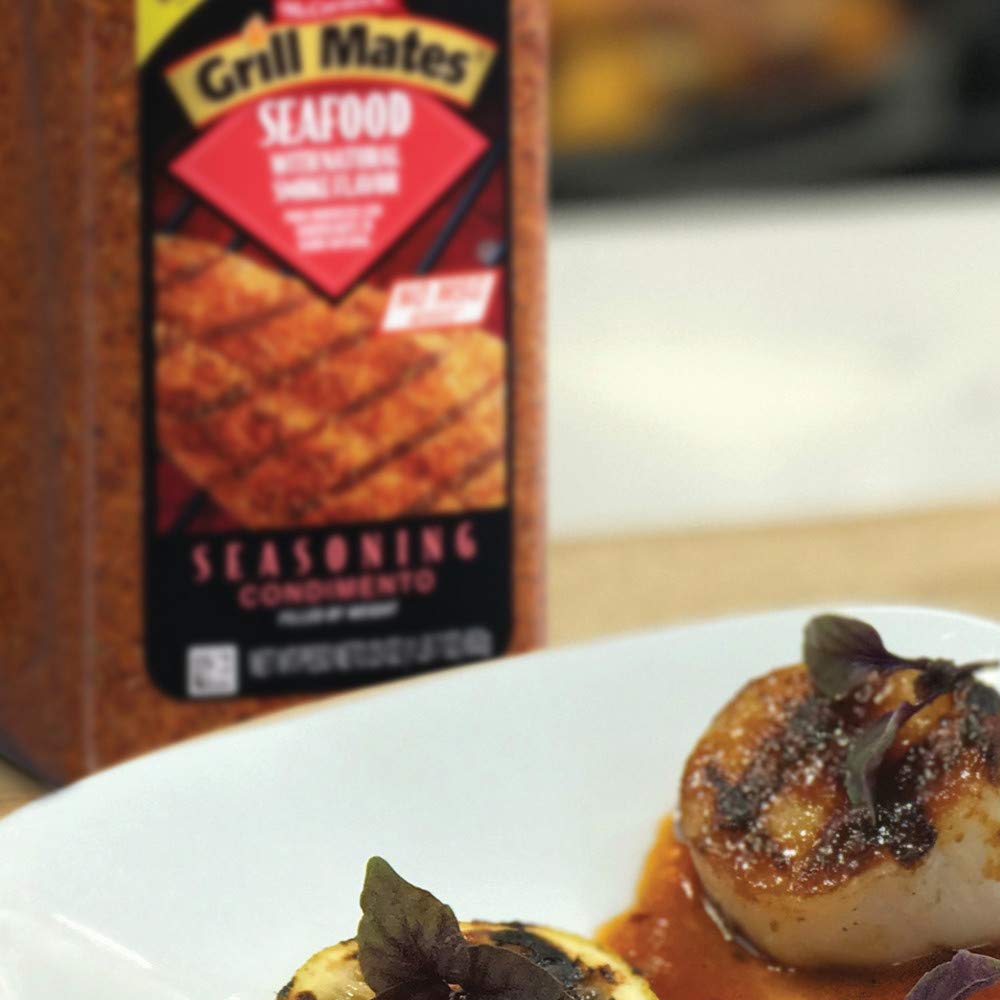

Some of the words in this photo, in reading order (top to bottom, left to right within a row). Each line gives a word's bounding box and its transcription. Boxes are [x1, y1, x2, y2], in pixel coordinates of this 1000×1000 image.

[195, 29, 300, 102] Grill
[320, 23, 470, 85] Mates
[257, 90, 412, 147] SEAFOOD
[191, 521, 479, 583] SEASONING
[237, 569, 437, 609] CONDIMENTO
